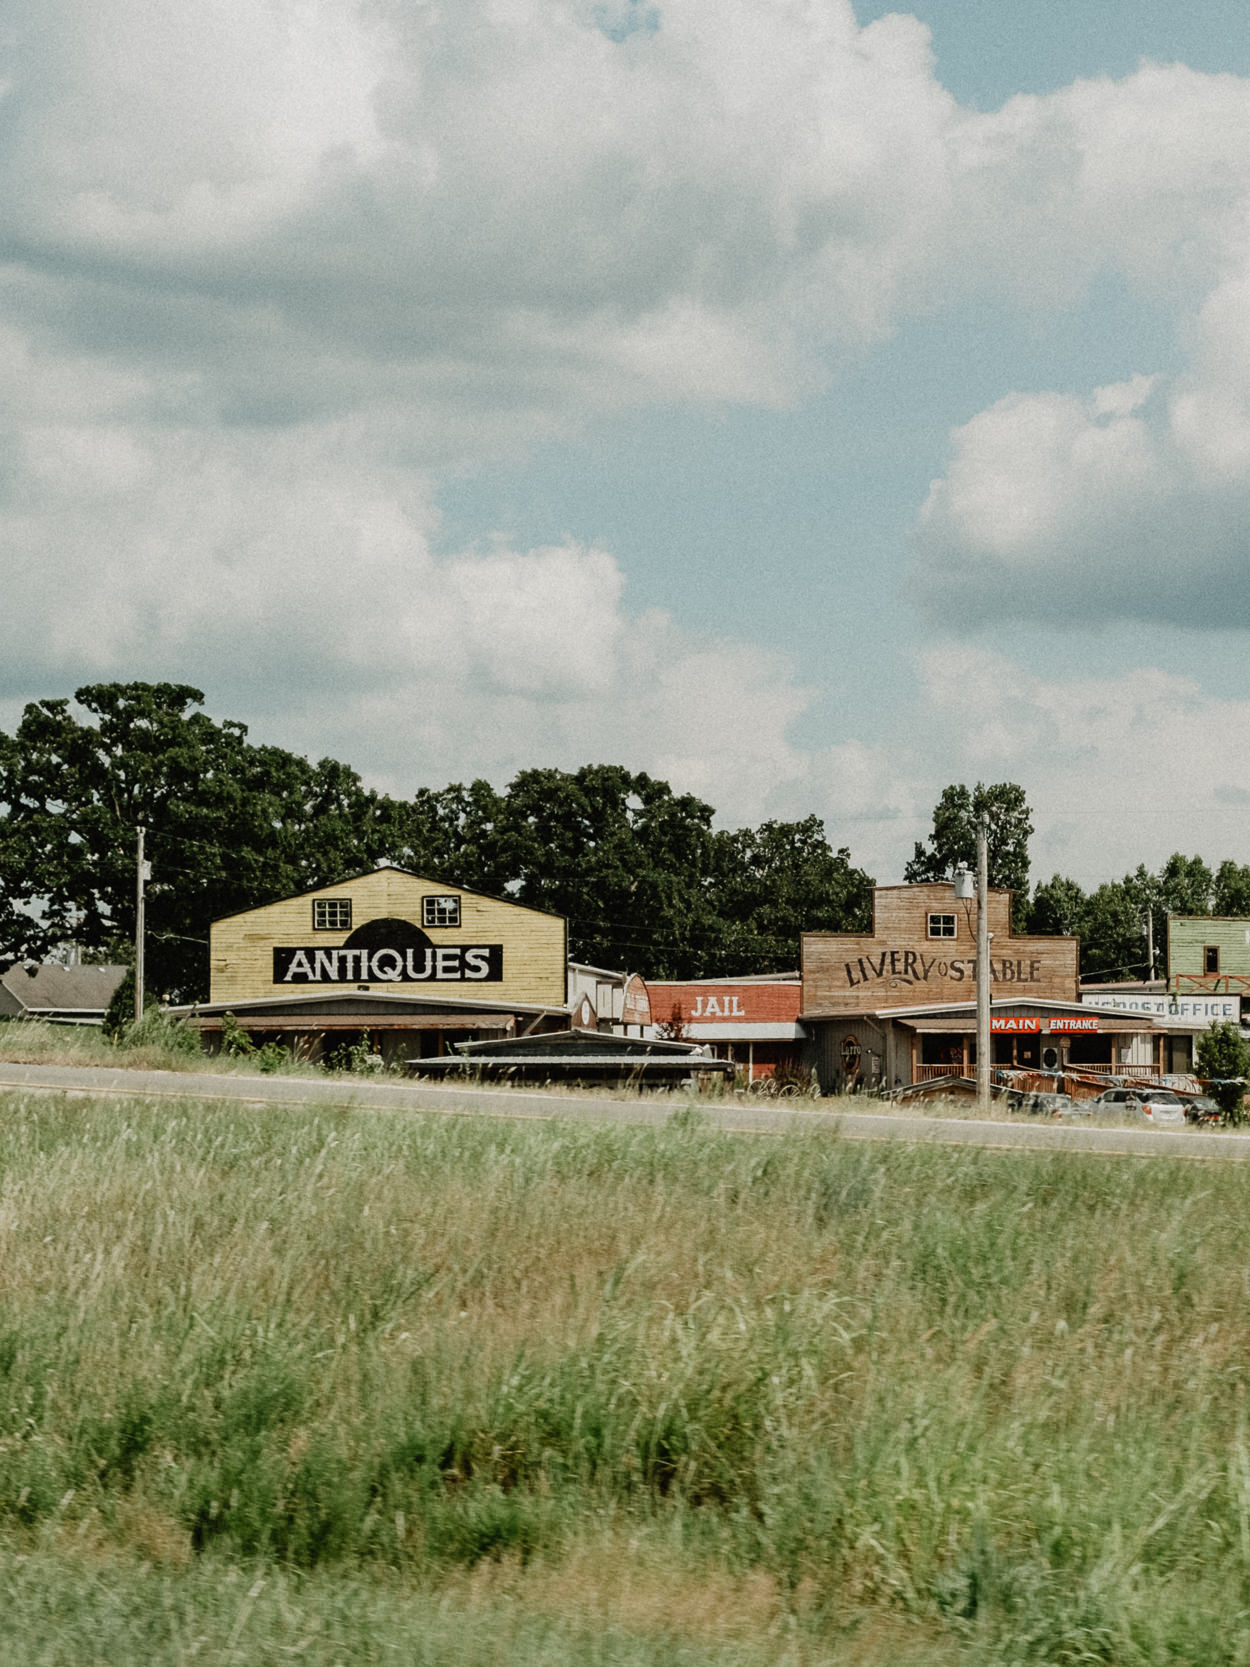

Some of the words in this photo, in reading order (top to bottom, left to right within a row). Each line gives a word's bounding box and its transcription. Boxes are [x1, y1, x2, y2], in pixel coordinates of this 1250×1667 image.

[283, 948, 490, 982] ANTIQUES
[844, 950, 937, 988] LIVERY
[690, 996, 746, 1017] JAIL
[1168, 1003, 1233, 1017] OFFICE
[991, 1018, 1037, 1030] MAIN
[1050, 1018, 1099, 1030] ENTRANCE
